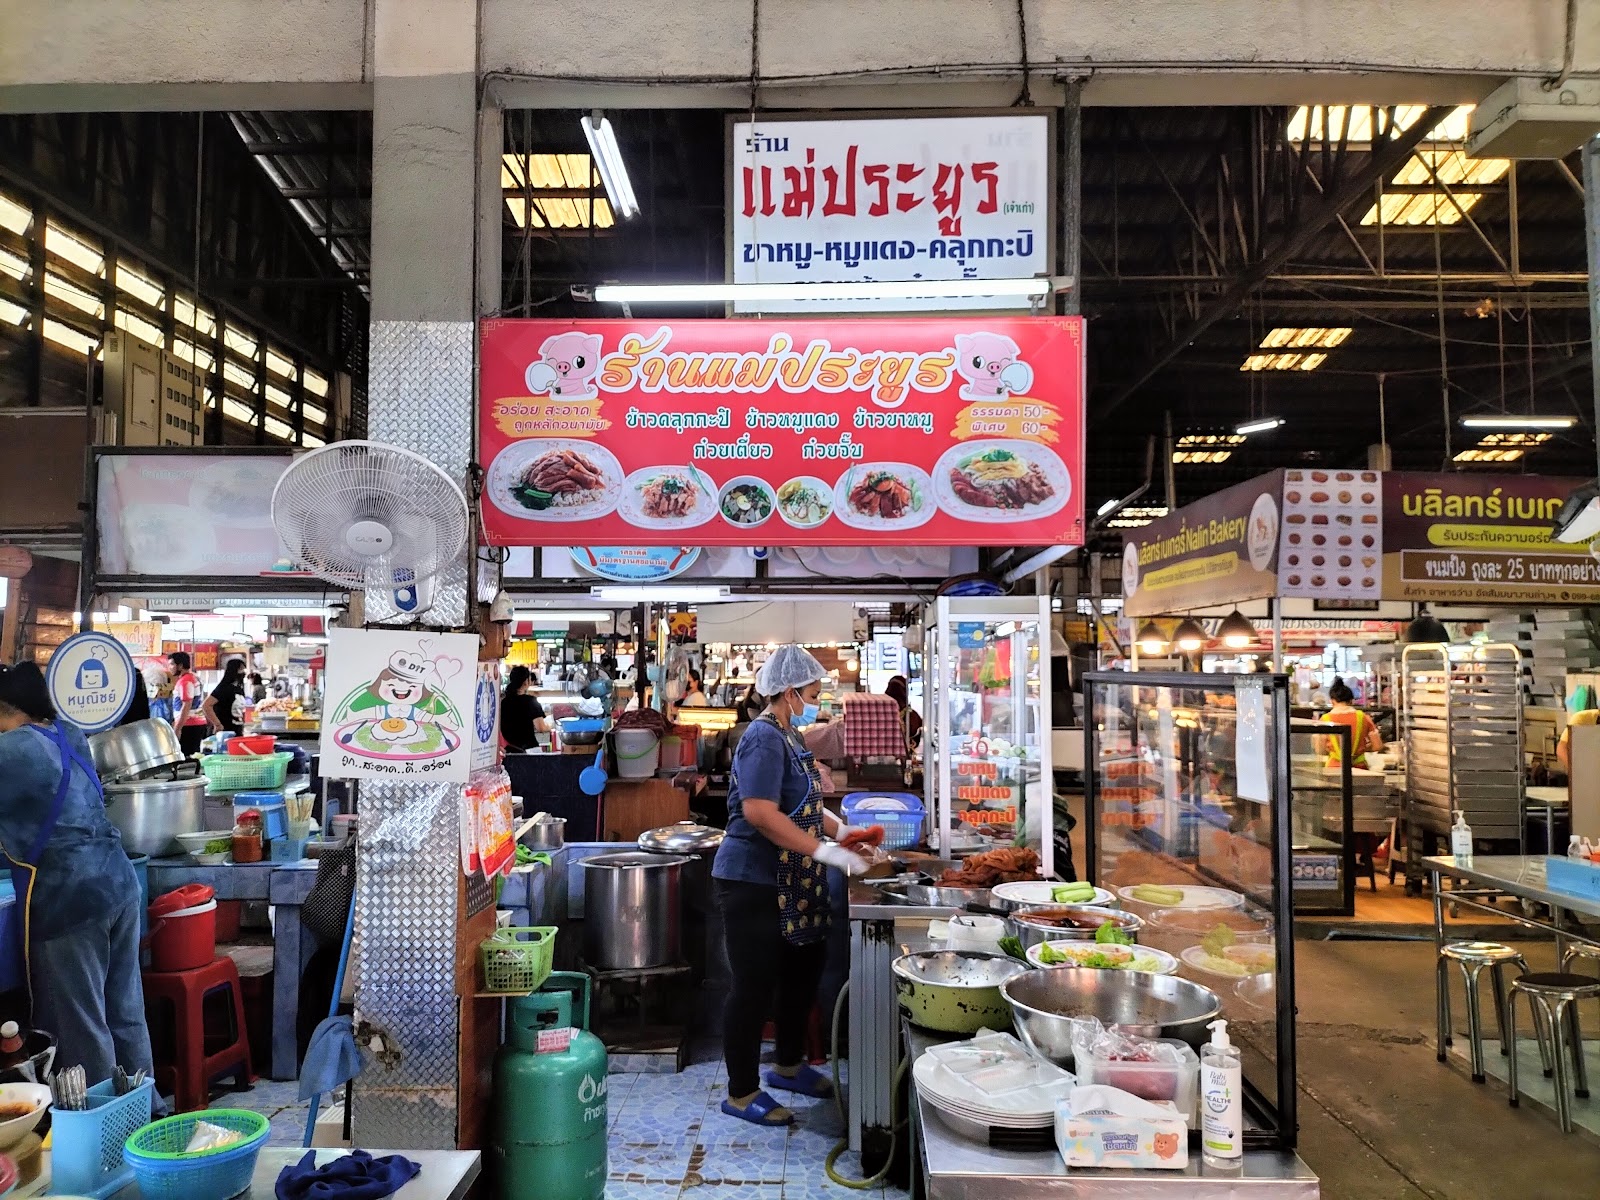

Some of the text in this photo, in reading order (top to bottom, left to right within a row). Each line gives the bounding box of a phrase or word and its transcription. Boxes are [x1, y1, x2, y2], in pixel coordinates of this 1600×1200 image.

[746, 133, 789, 152] ร้าน
[742, 145, 1035, 237] แม่ประยูร (เจ้าเก่า)
[743, 229, 1033, 270] ขาหมู-หมูแดง-คลุกกะปิ
[600, 329, 956, 402] ร้านแม่ประยูร
[500, 403, 590, 416] อร่อย สะอาด
[972, 408, 1019, 417] ธรรมดา
[514, 418, 606, 434] ถูกหลักอนามัย
[626, 407, 933, 433] ข้าวคลุกกะปิ ข้าวหมูแดง ข้าวขาหมู
[972, 421, 1006, 432] พิเศษ
[694, 433, 863, 460] ก๋วยเตี๋ยว ก๋วยจั๊บ
[1507, 496, 1563, 520] เบเก
[1186, 516, 1247, 552] Nalin Bakery
[1443, 529, 1554, 544] รับประกันความอร่อ
[1507, 558, 1525, 580] 25
[68, 689, 116, 708] หนูณิชย์
[957, 762, 997, 779] ขาหมู
[958, 786, 1011, 804] หมูแดง
[958, 806, 1016, 827] คลุกกะปิ
